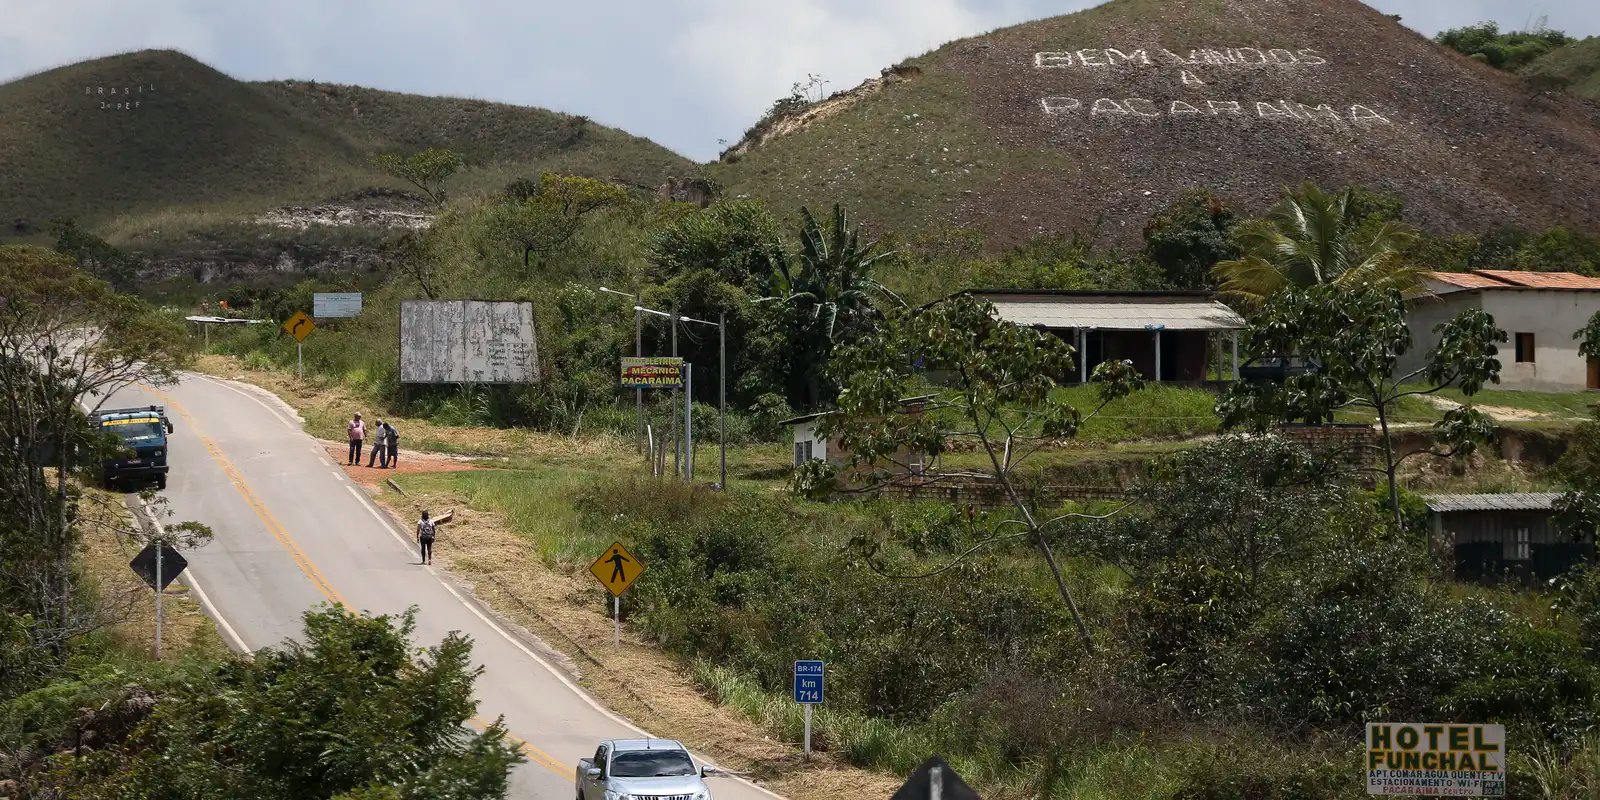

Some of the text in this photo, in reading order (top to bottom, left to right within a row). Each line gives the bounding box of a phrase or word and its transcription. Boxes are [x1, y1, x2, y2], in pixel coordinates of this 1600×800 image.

[1035, 47, 1327, 68] BEM VINDOS
[85, 83, 155, 95] BRASIL
[802, 678, 816, 688] km
[799, 690, 819, 701] 714
[1370, 725, 1499, 751] HOTEL
[1369, 750, 1498, 771] FUNCHAL
